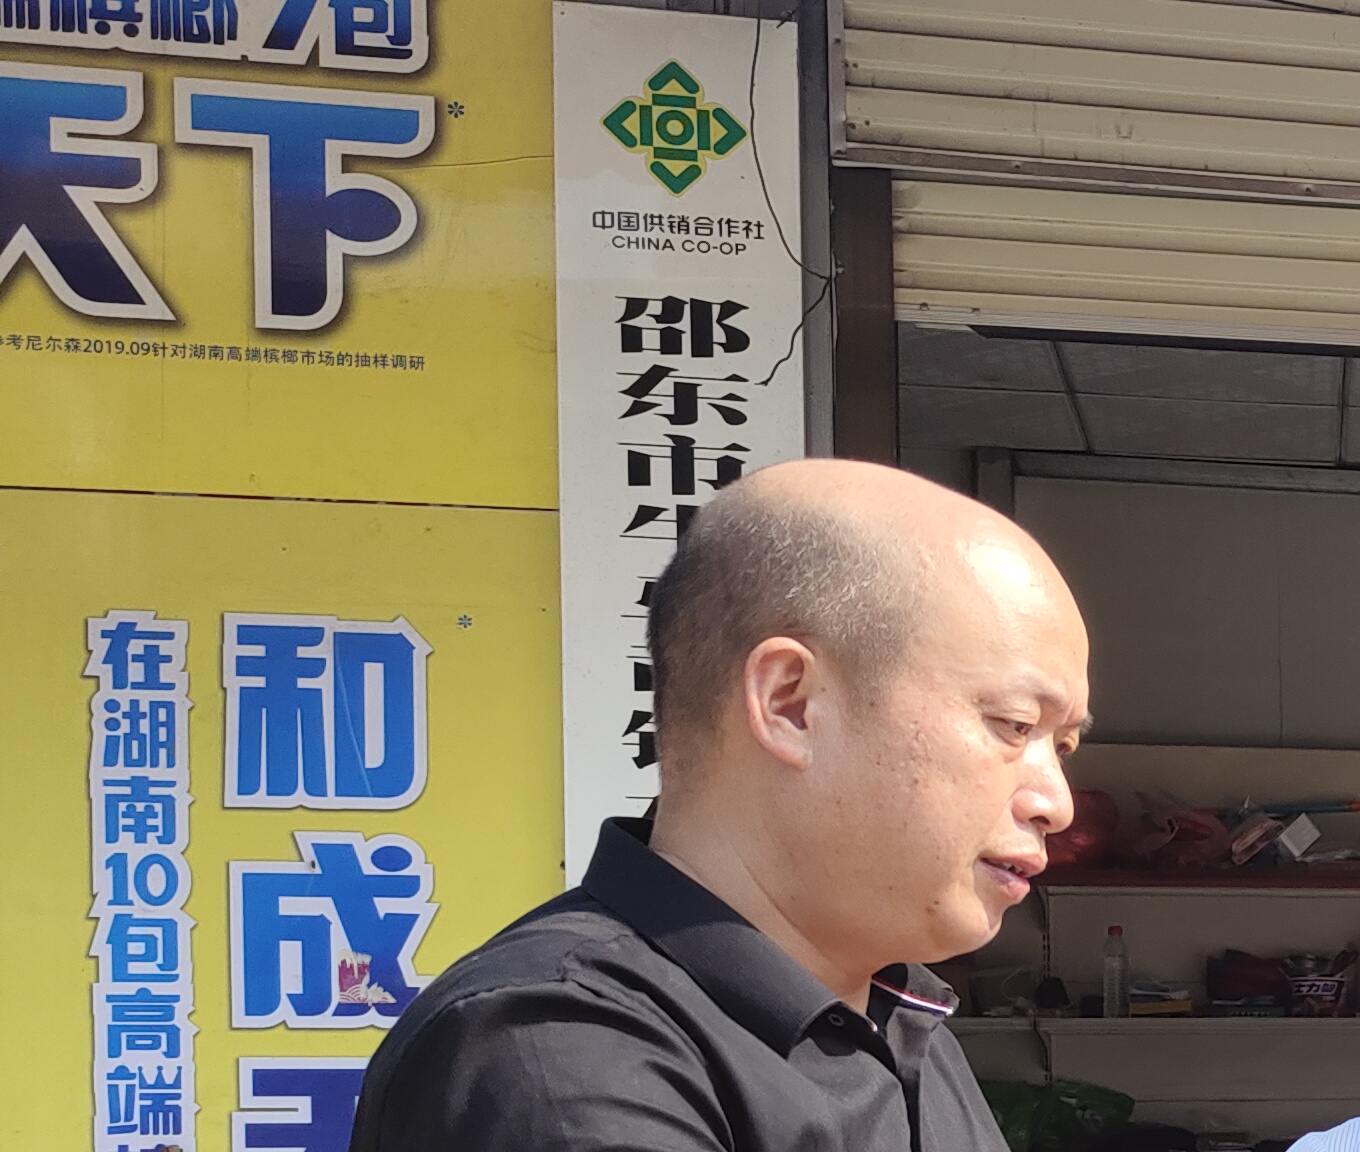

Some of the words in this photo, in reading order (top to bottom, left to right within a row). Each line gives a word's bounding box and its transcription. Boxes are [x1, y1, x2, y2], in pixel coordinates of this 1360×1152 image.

[592, 210, 766, 240] 中国供销合作社
[611, 235, 676, 252] CHINA
[681, 239, 748, 256] CO-OP
